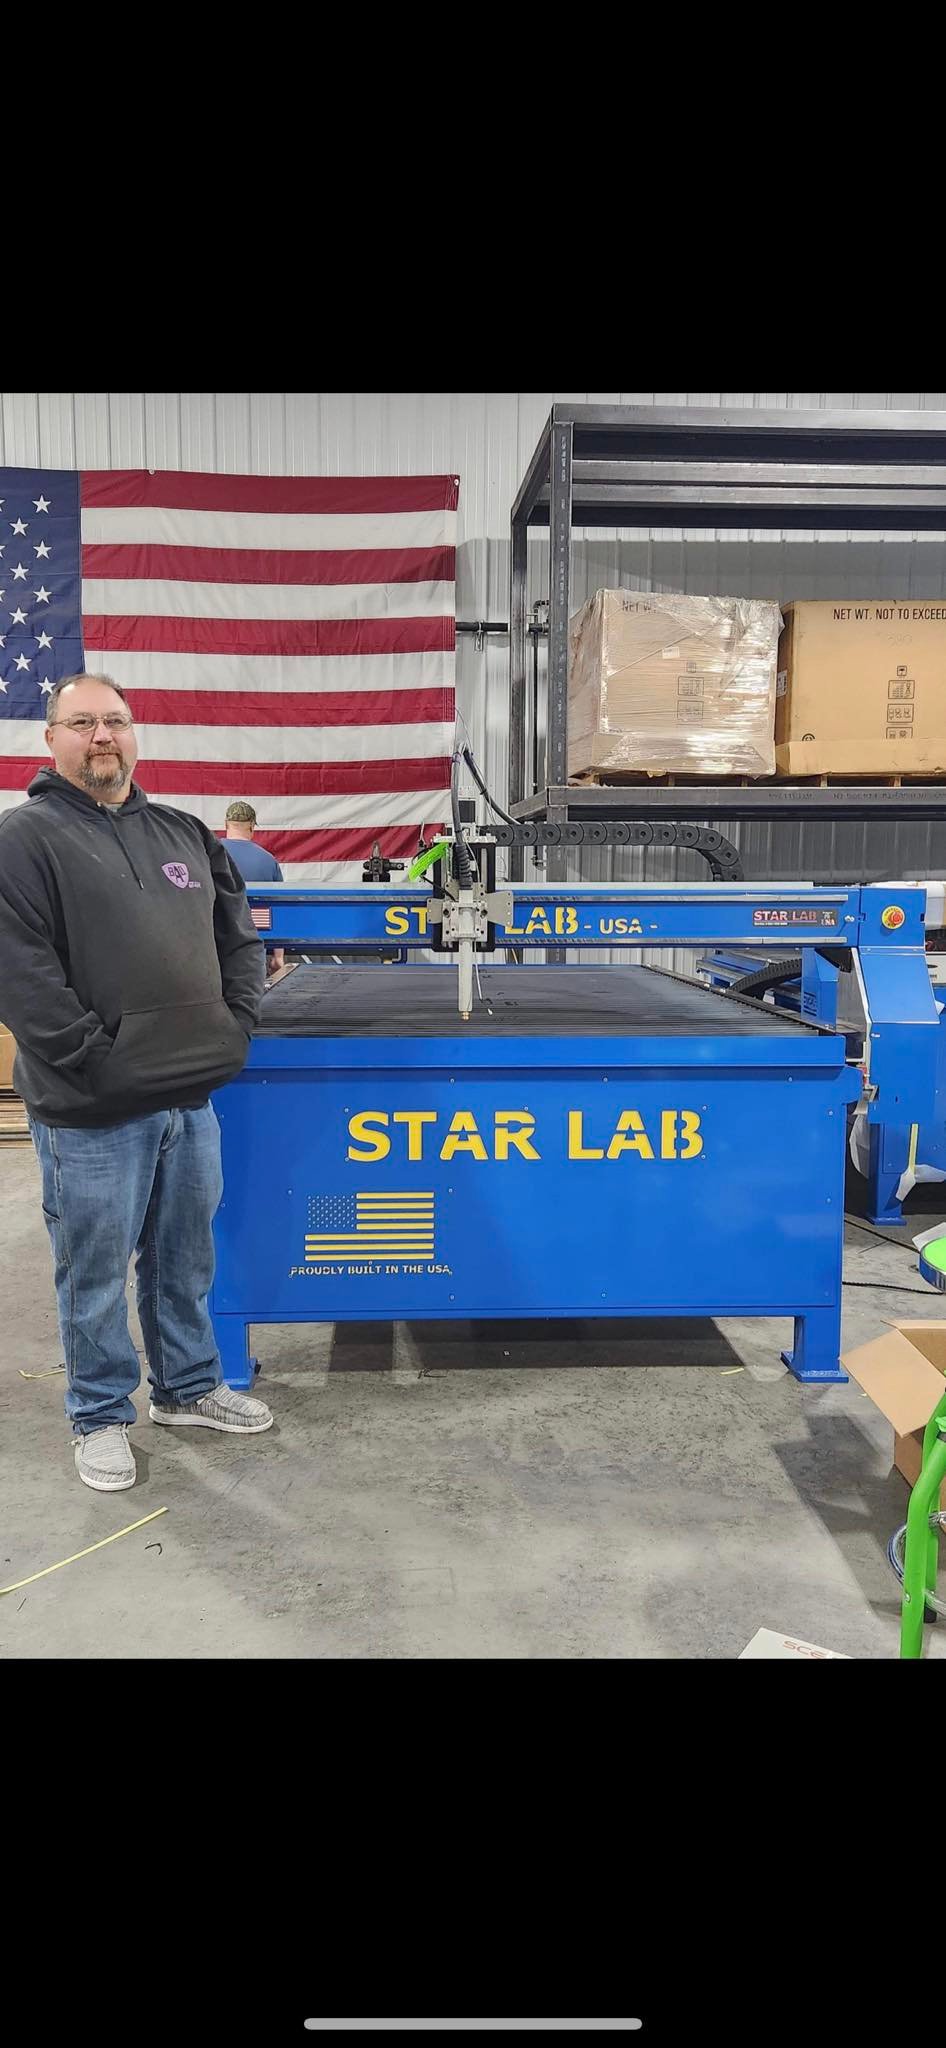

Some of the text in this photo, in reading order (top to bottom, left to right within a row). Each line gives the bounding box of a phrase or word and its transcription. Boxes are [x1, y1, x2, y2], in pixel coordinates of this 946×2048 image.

[833, 608, 946, 620] NET WT. NOT TO EXCEED
[753, 910, 788, 921] STAR
[792, 910, 817, 921] LAB
[600, 918, 643, 935] USA
[347, 1109, 704, 1162] STAR LAB
[291, 1264, 450, 1275] PROUDLY BUILT IN THE USA
